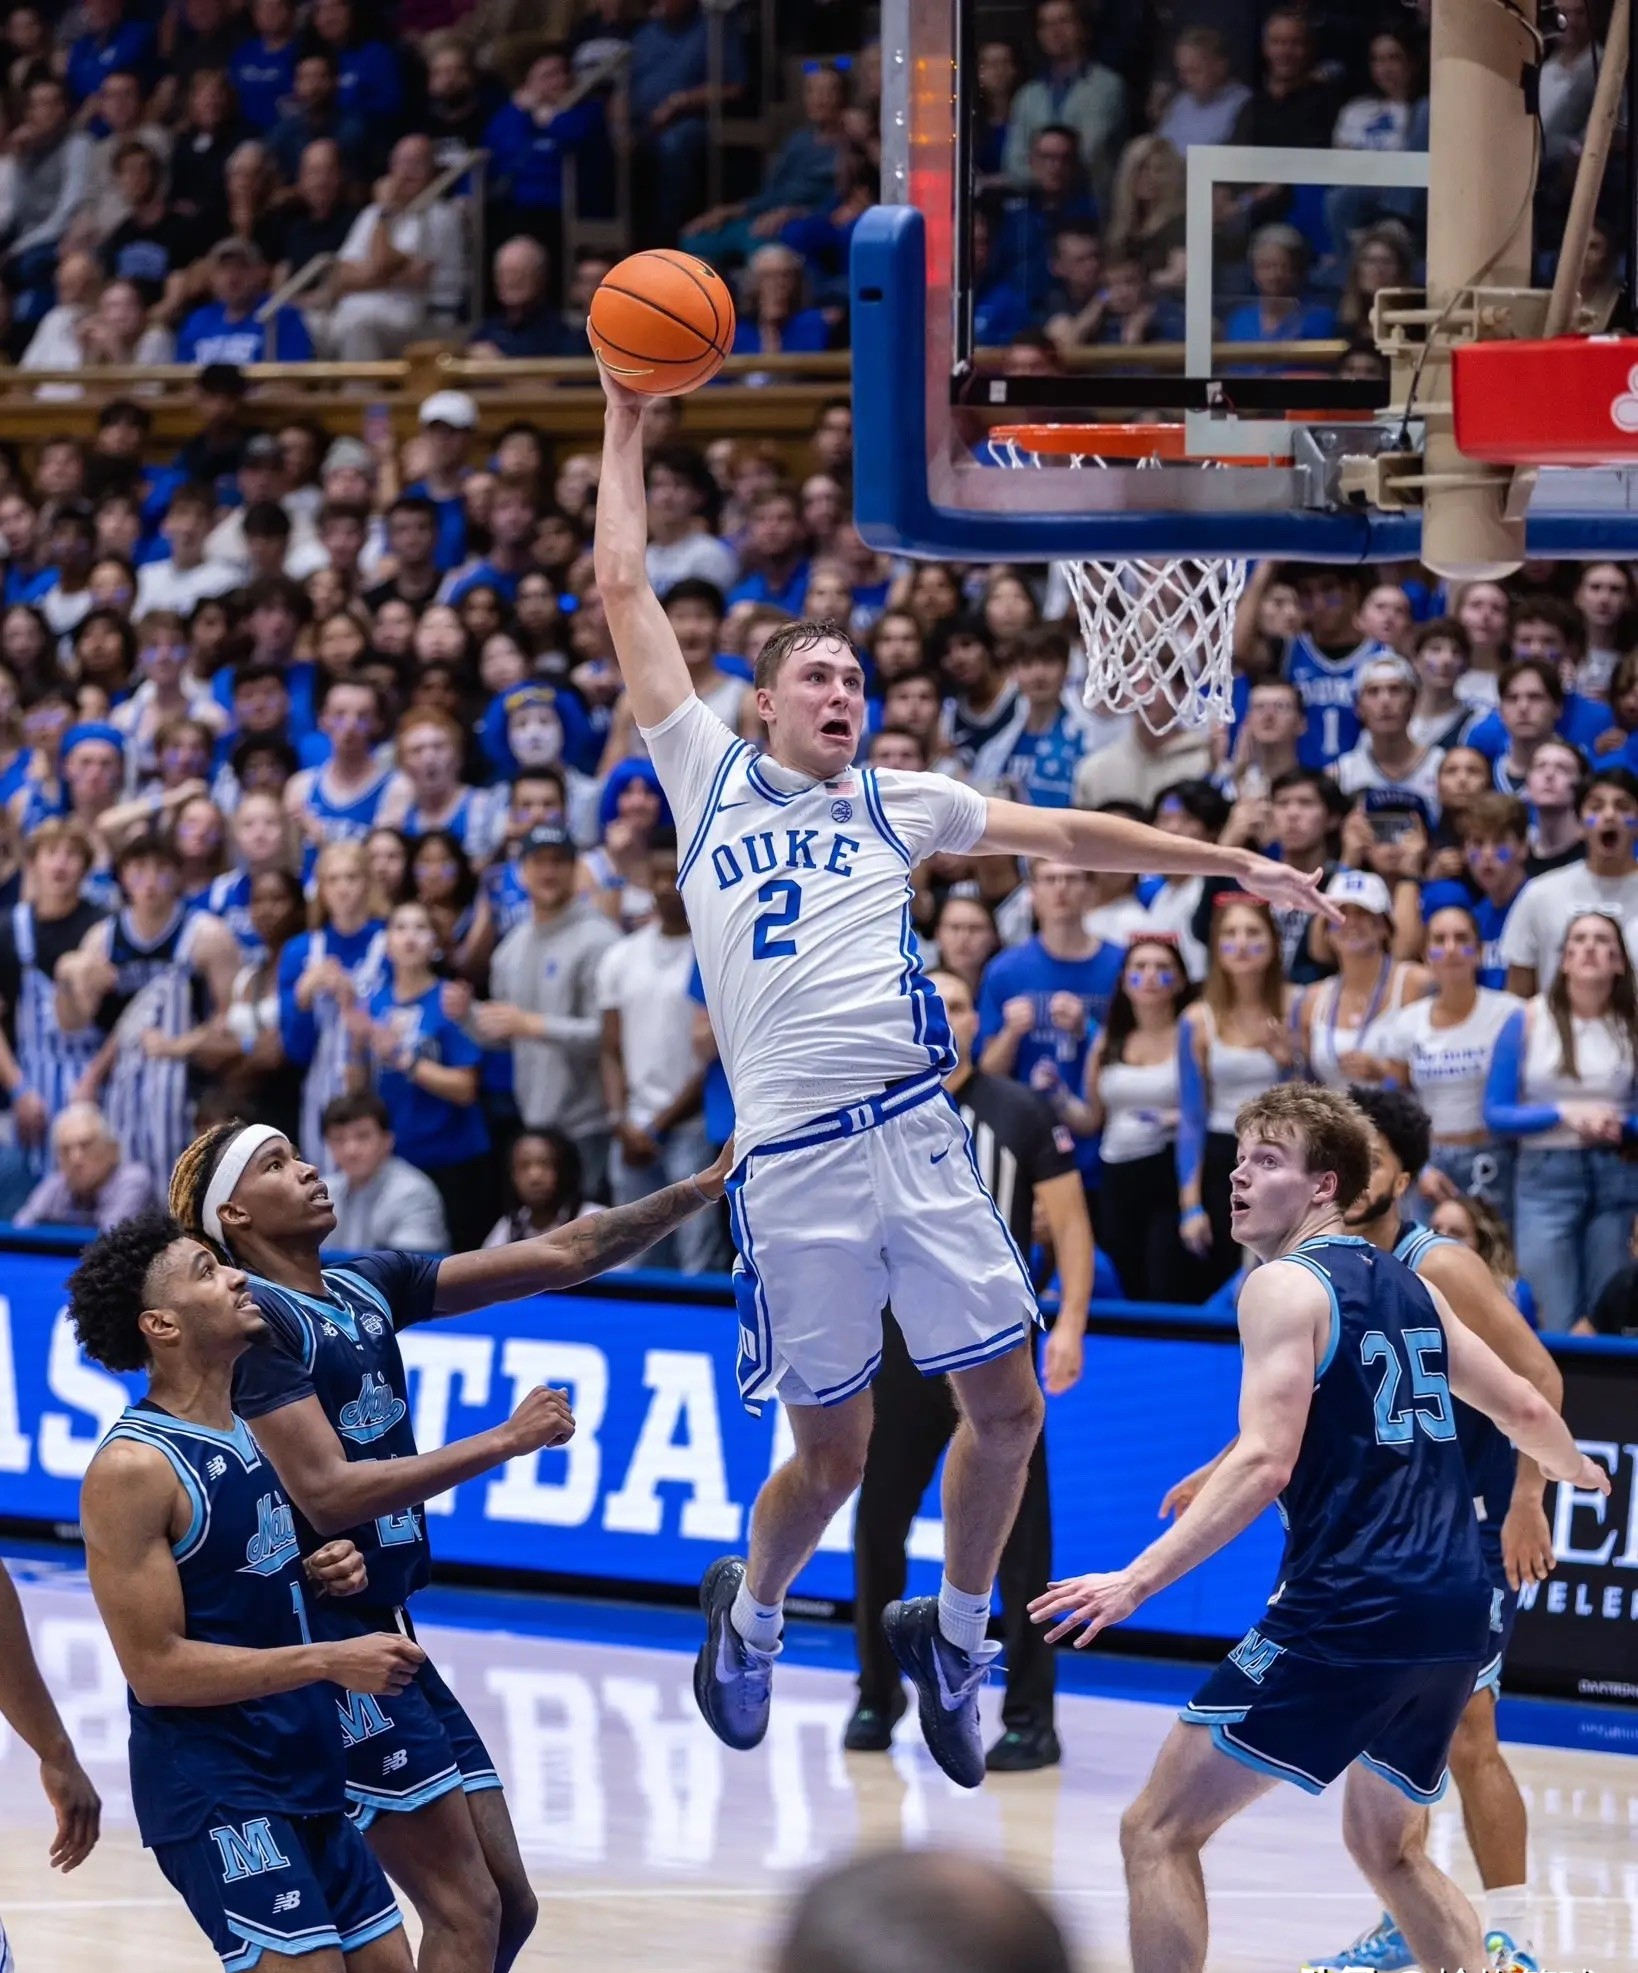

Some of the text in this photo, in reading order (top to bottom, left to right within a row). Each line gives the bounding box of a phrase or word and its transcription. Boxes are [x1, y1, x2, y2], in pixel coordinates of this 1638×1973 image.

[711, 829, 860, 891] DUKE
[753, 879, 802, 960] 2
[1359, 1327, 1457, 1445] 25
[1228, 1626, 1288, 1685] M
[209, 1816, 291, 1884] M
